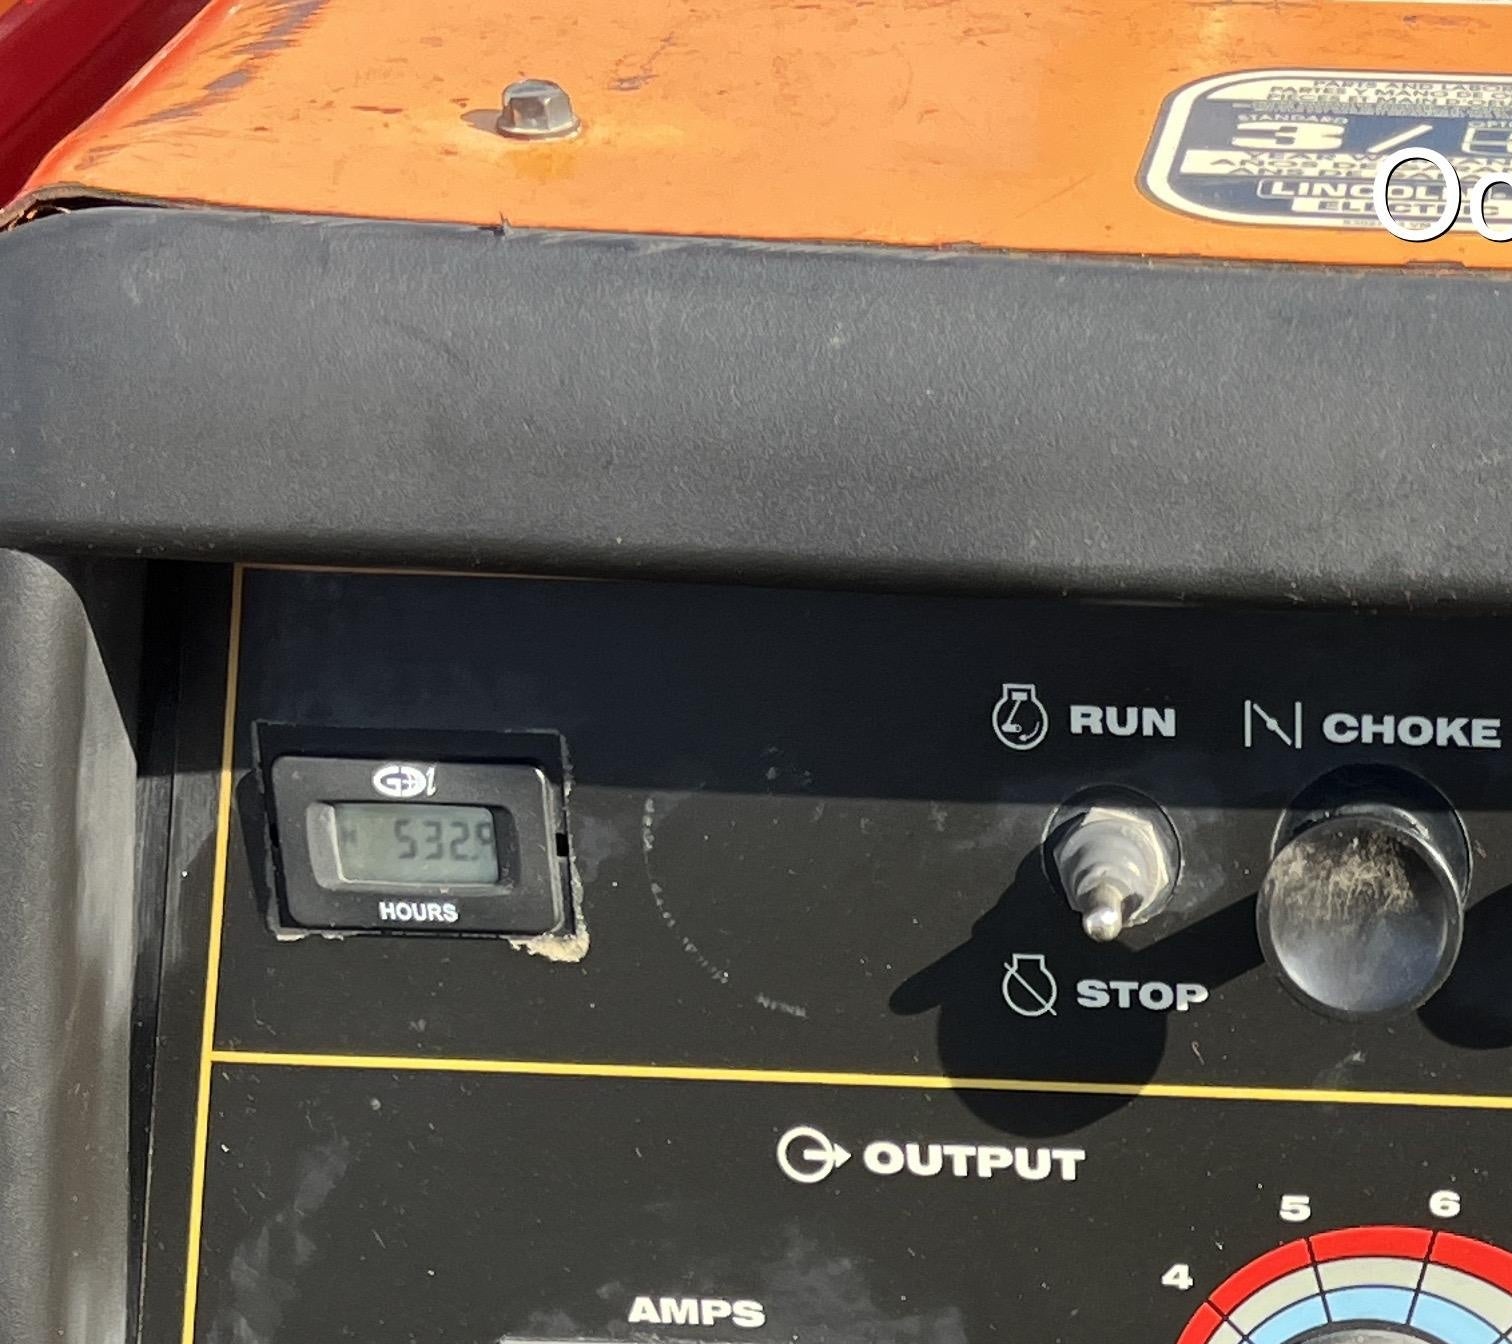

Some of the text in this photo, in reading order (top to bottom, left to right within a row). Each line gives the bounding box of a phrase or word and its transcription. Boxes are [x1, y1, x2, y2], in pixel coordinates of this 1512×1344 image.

[1375, 88, 1444, 99] MANO
[1455, 90, 1484, 100] DE
[1388, 81, 1434, 91] AND
[1231, 121, 1345, 150] 3
[1068, 703, 1177, 738] RUN
[1321, 710, 1502, 749] CHOKE
[378, 901, 459, 923] HOURS
[1075, 978, 1212, 1013] STOP
[863, 1141, 1087, 1181] OUTPUT
[1279, 1194, 1312, 1222] 5
[1428, 1191, 1462, 1218] 6
[1161, 1263, 1194, 1291] 4
[628, 1296, 767, 1329] AMPS
